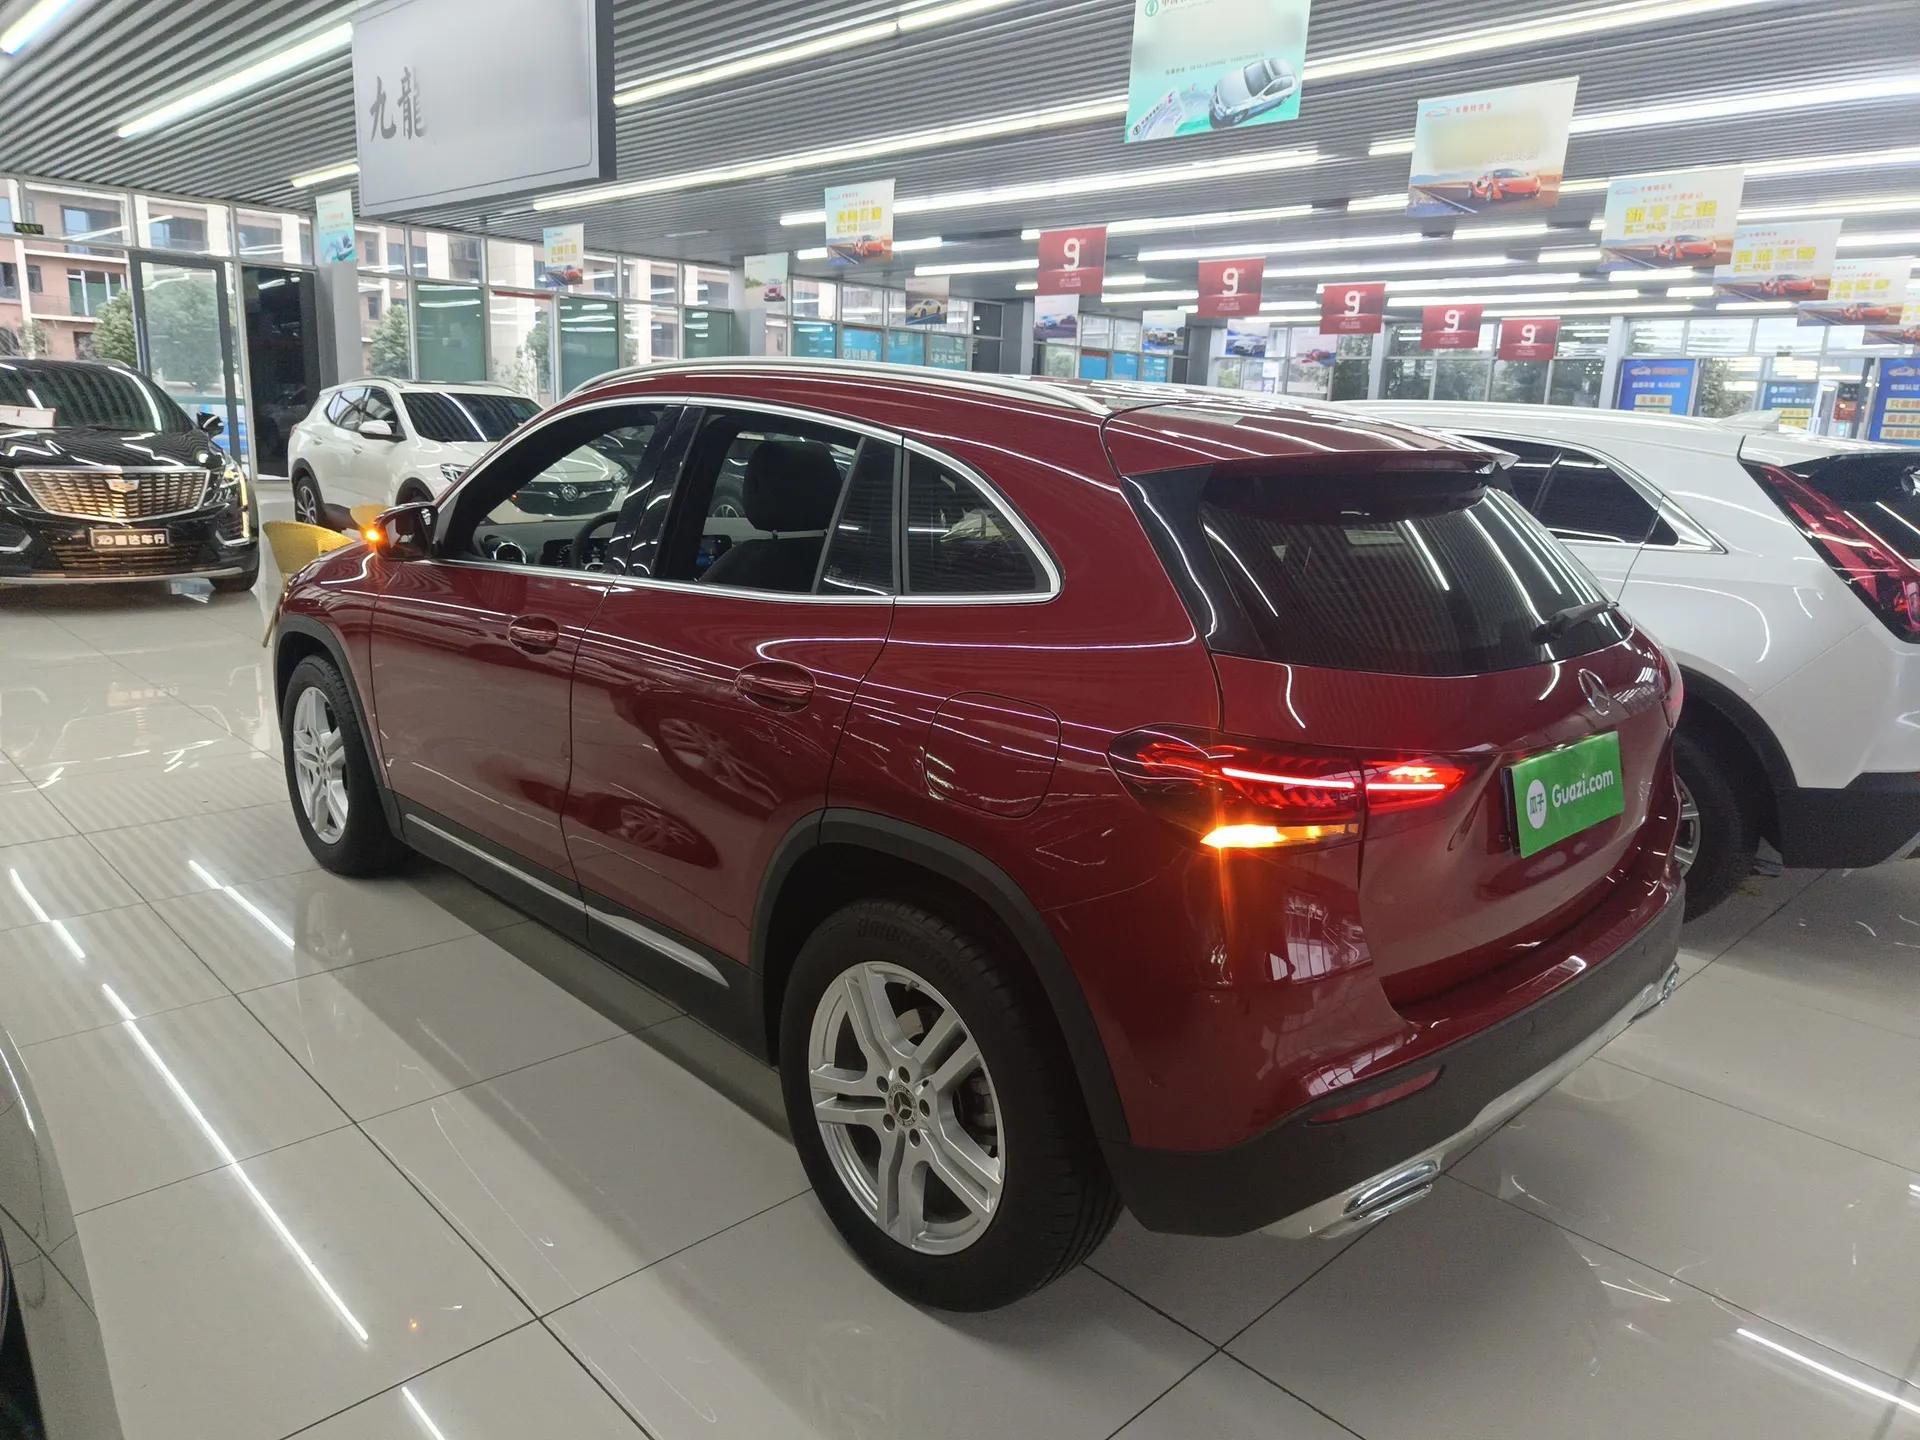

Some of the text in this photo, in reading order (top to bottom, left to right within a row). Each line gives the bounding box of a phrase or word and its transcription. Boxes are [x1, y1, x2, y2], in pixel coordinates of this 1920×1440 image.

[1064, 237, 1080, 272] 9
[1222, 267, 1239, 297] 9
[1344, 290, 1360, 317] 9
[1443, 309, 1460, 333] 9
[1521, 324, 1536, 345] 9
[1552, 769, 1614, 808] Guazi.com
